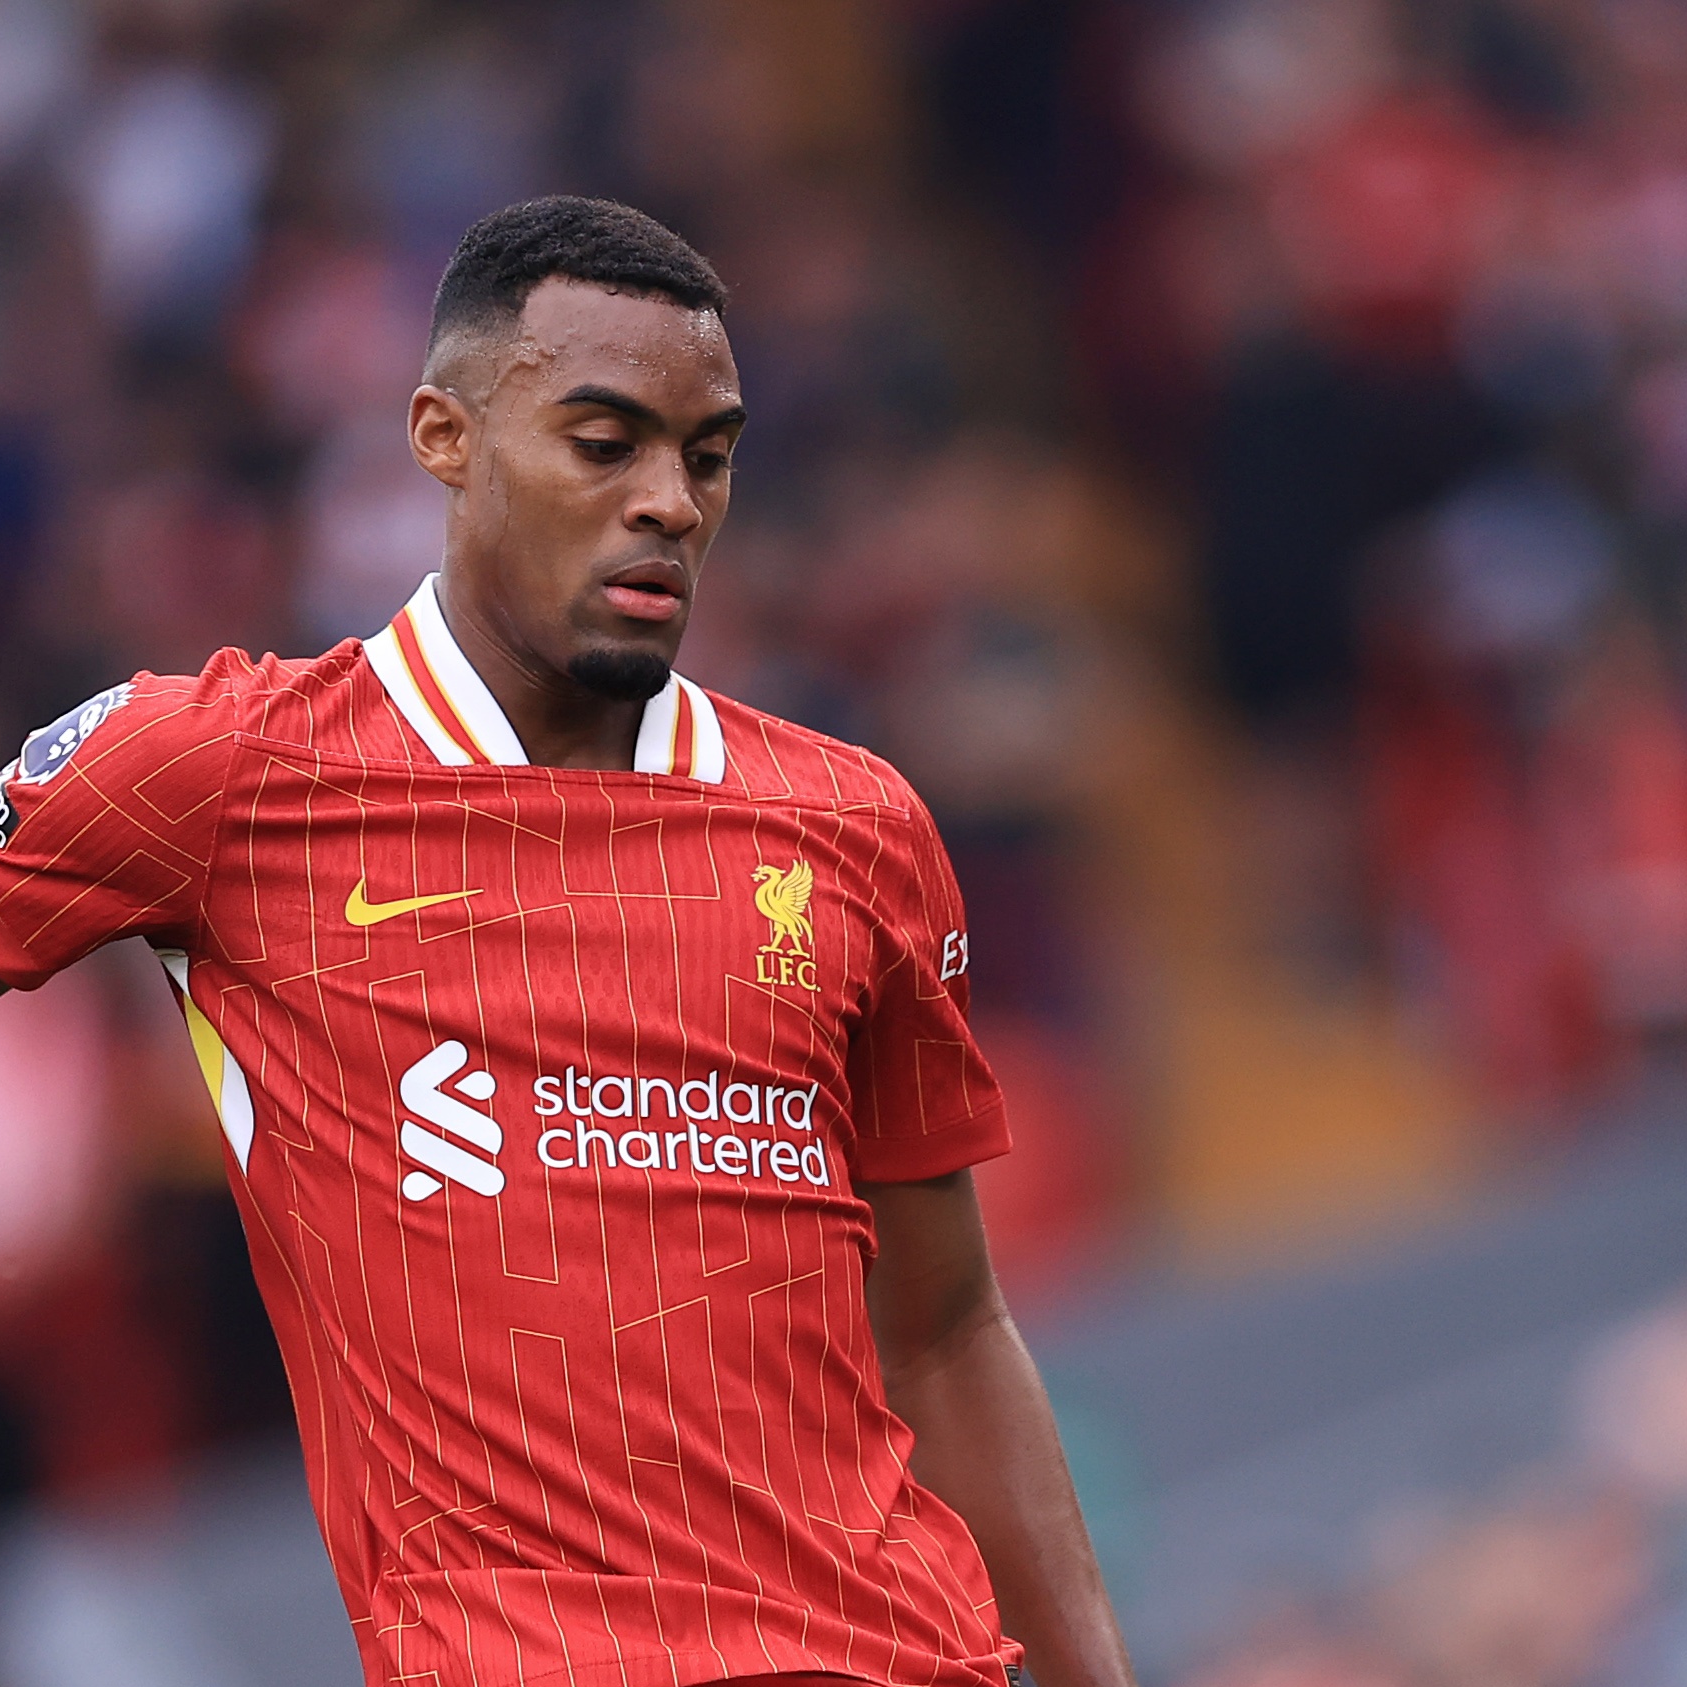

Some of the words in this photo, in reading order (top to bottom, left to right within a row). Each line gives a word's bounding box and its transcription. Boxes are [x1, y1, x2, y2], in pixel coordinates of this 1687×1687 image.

[755, 954, 822, 992] L.F.C.
[533, 1065, 819, 1131] standard
[537, 1119, 830, 1187] chartered
